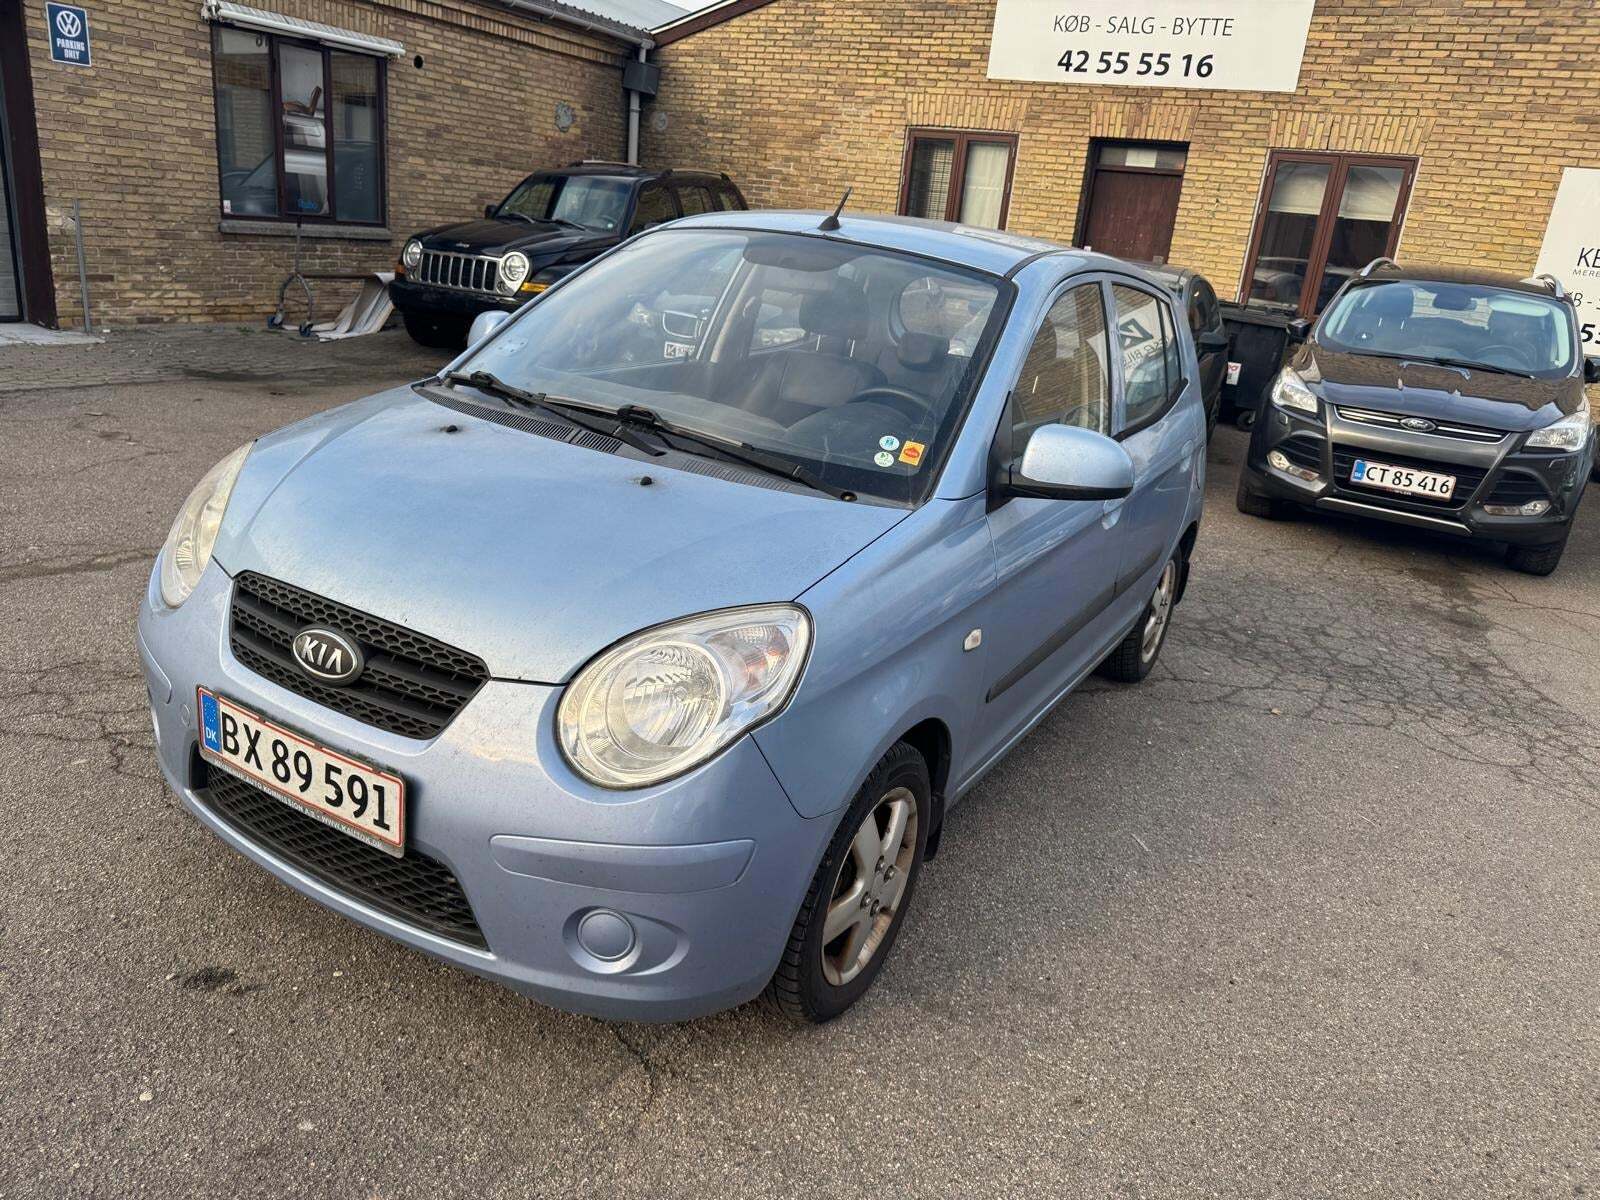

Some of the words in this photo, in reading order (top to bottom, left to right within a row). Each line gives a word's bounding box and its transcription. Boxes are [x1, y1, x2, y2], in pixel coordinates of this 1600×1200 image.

[1053, 14, 1090, 33] KØB
[1107, 16, 1155, 35] SALG
[1172, 18, 1234, 37] BYTTE
[56, 38, 85, 51] PARKING
[64, 49, 80, 60] ONLY
[1057, 50, 1089, 73] 42
[1096, 51, 1130, 75] 55
[1136, 53, 1171, 77] 55
[1182, 54, 1214, 78] 16
[1366, 466, 1390, 482] CT
[1392, 470, 1415, 488] 85
[1417, 476, 1450, 494] 416
[301, 634, 343, 674] KIA
[205, 727, 217, 743] DK
[222, 711, 263, 771] BX
[271, 739, 313, 793] 89
[324, 762, 390, 831] 591
